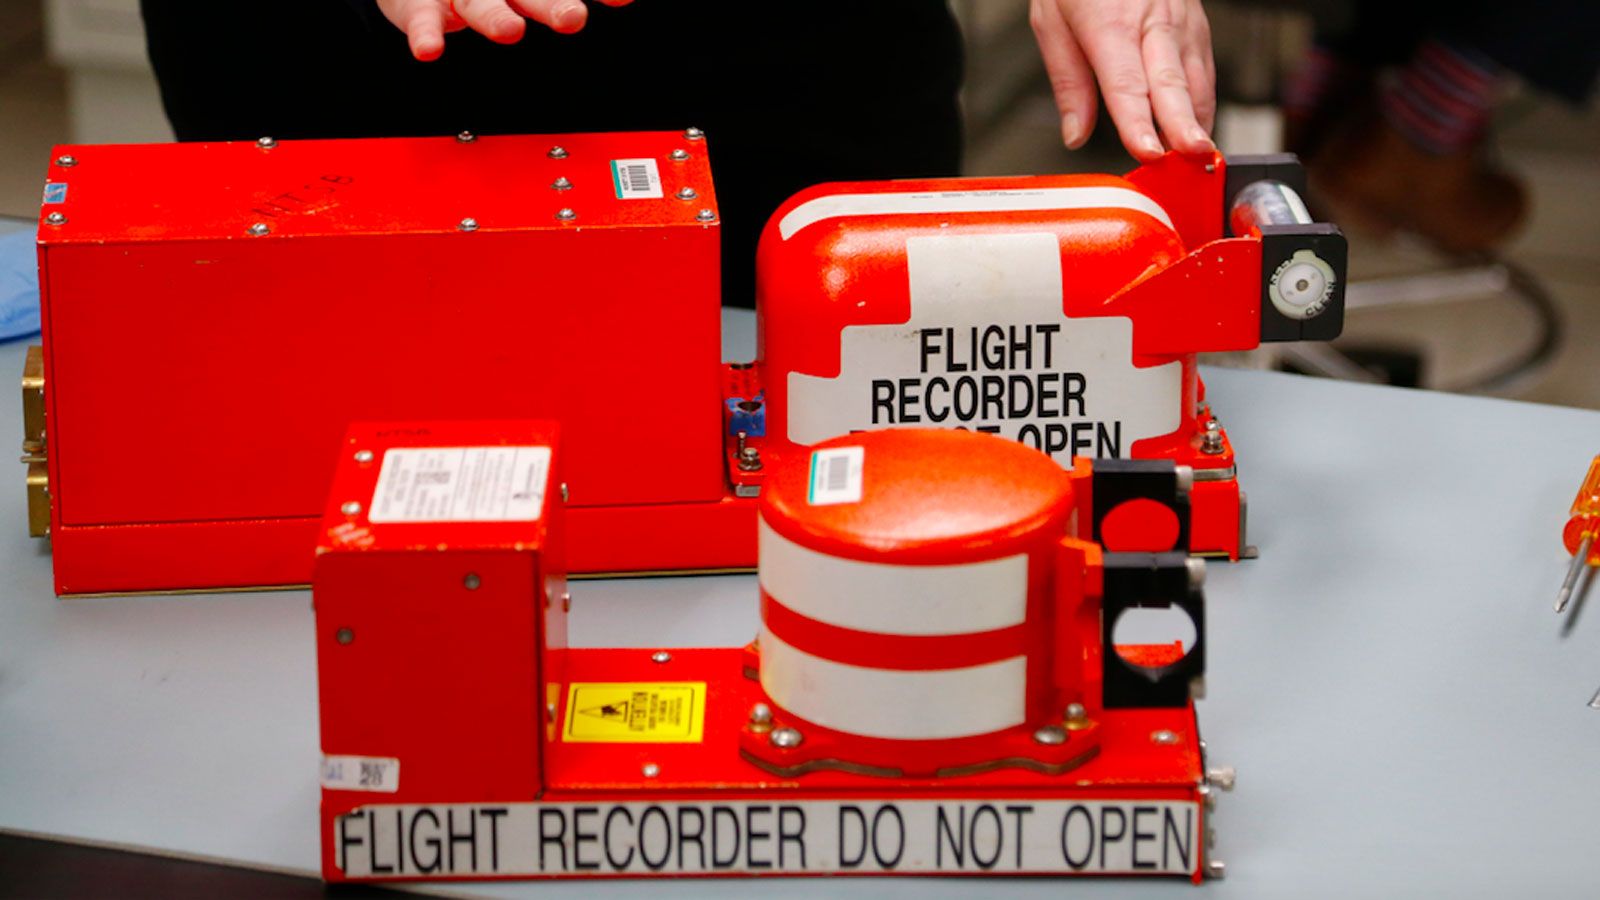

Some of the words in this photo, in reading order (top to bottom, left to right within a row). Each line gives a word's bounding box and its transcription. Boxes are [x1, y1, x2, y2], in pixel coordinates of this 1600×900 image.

[919, 324, 1061, 374] FLIGHT
[871, 372, 1087, 425] RECORDER
[340, 806, 508, 874] FLIGHT
[537, 805, 808, 872] RECORDER
[838, 804, 906, 870] DO
[936, 804, 1035, 871] NOT
[1060, 804, 1192, 871] OPEN
